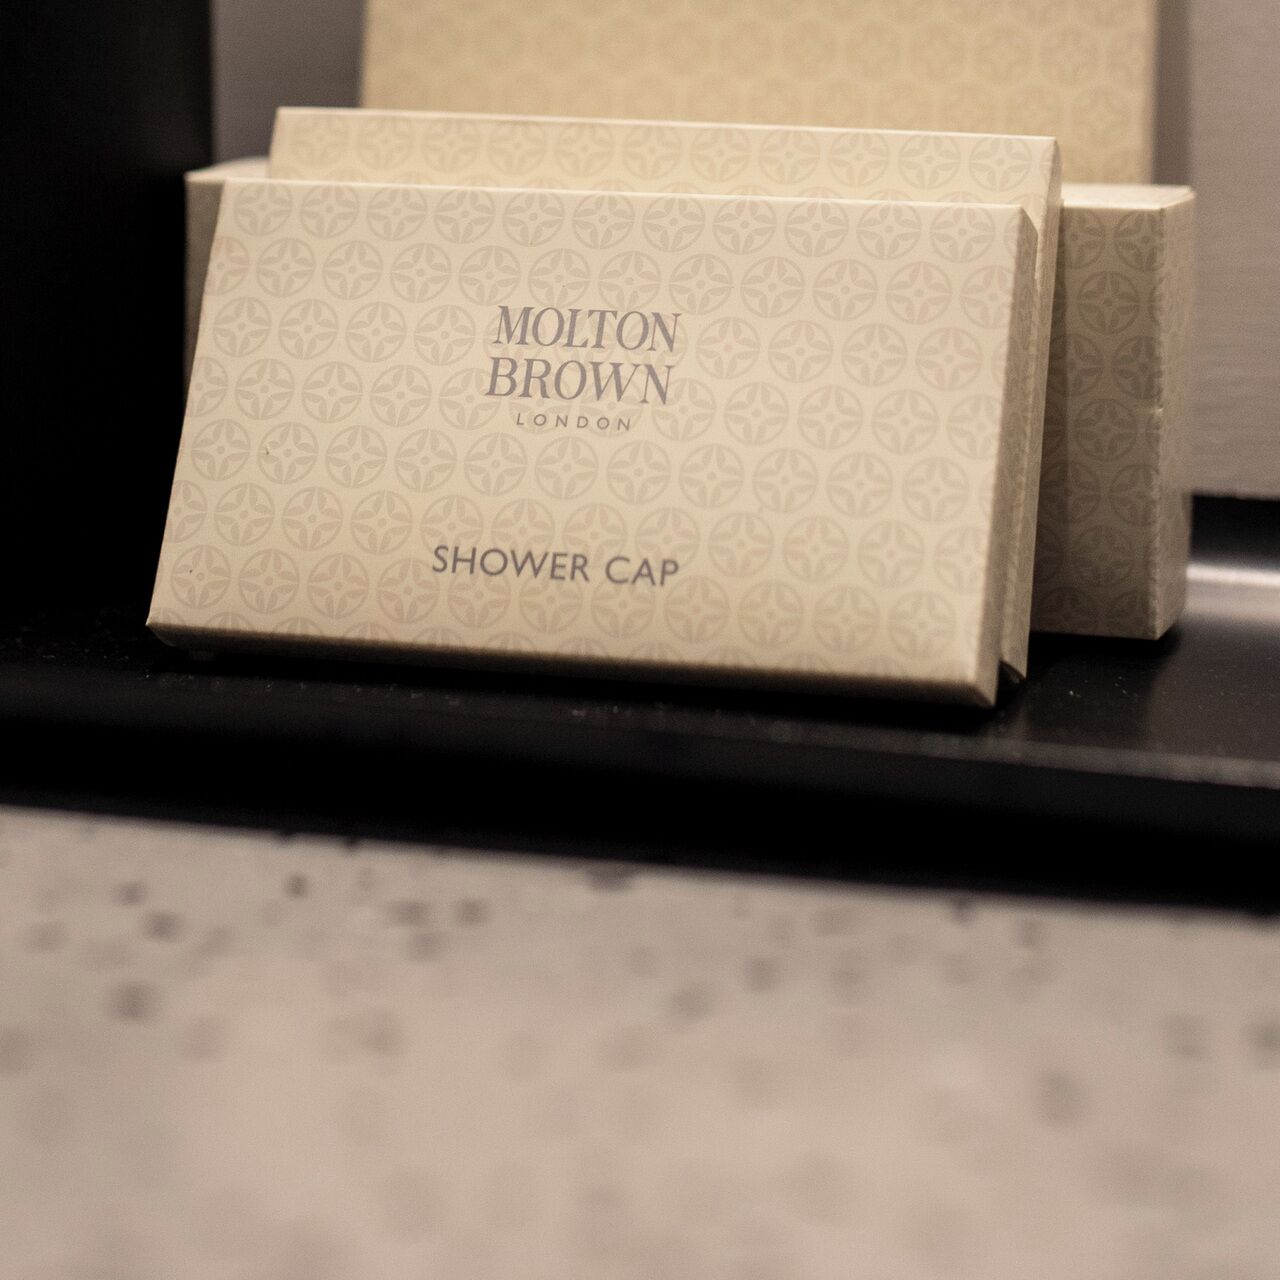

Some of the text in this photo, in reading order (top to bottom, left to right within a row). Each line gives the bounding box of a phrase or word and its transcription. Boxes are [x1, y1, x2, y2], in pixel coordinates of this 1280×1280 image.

[492, 305, 682, 353] MOLTON
[484, 356, 675, 405] BROWN
[516, 413, 631, 431] LONDON
[432, 544, 680, 587] SHOWER CAP
